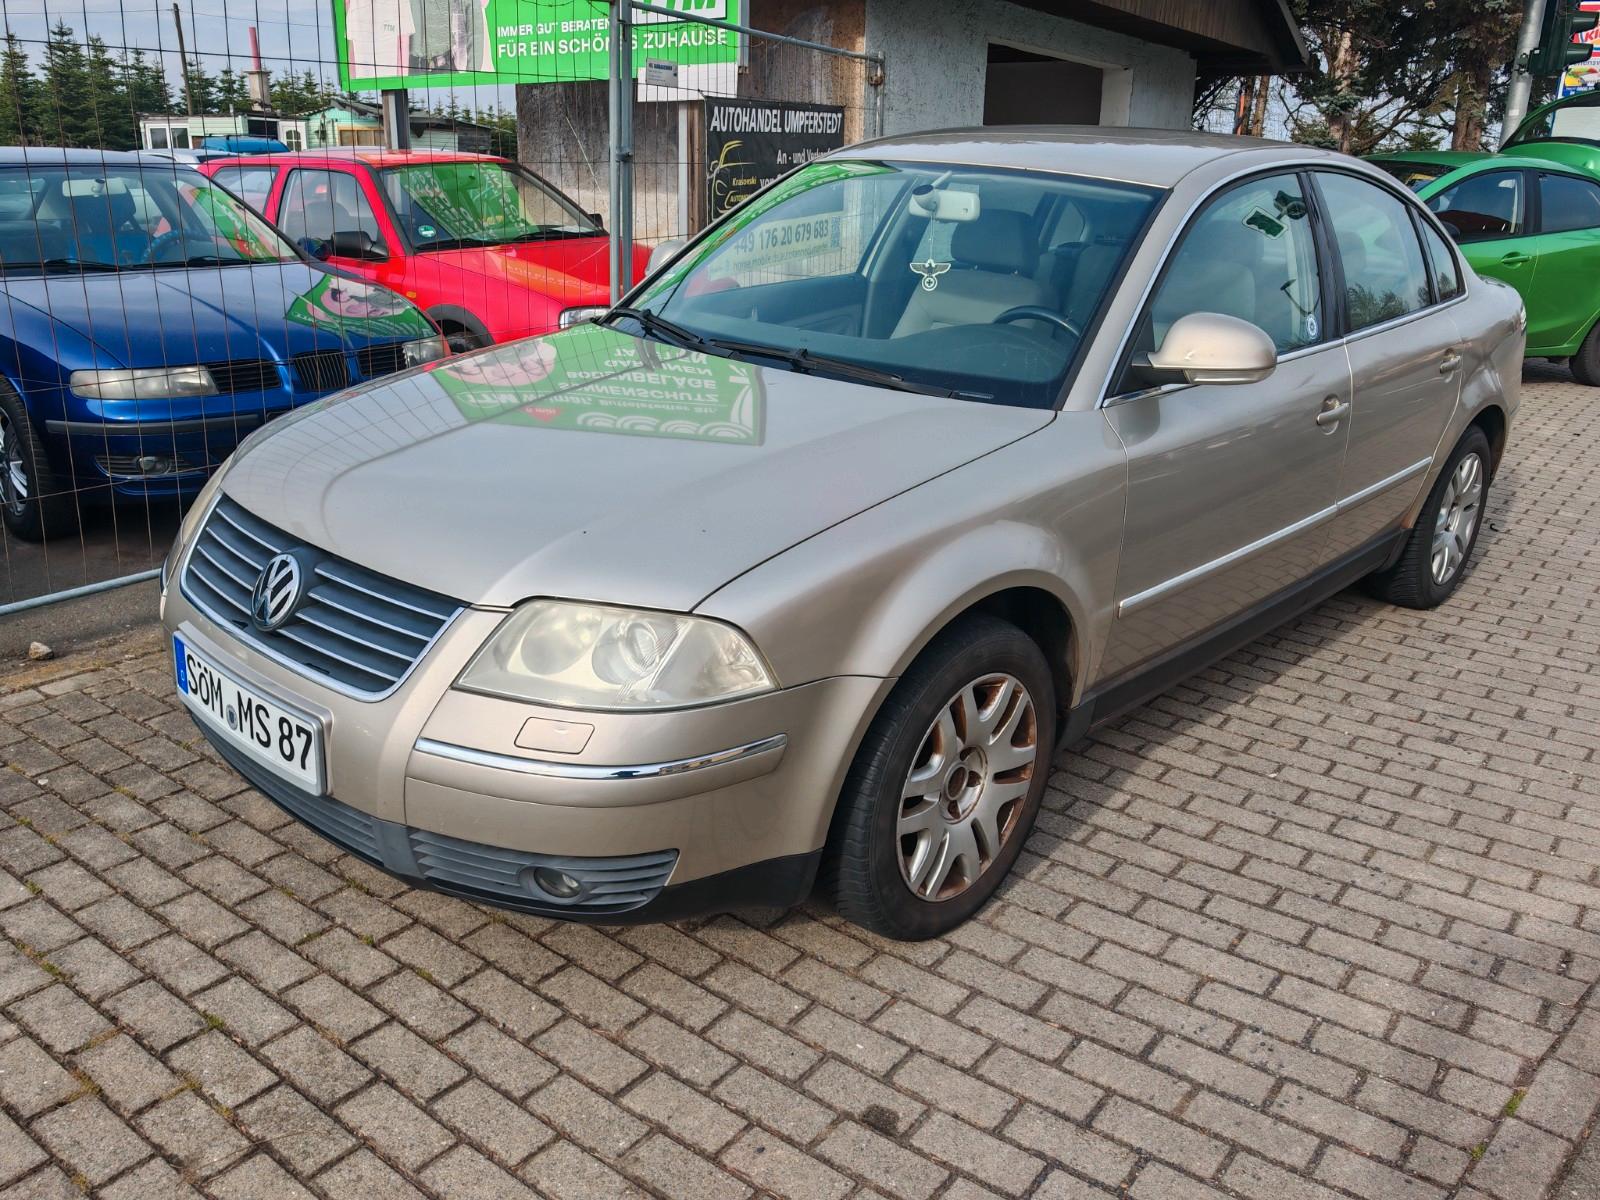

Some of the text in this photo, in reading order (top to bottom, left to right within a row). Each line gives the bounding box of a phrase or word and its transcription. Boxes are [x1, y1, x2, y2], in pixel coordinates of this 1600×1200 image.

[497, 24, 533, 37] IMMER
[536, 21, 559, 35] GUT
[498, 28, 728, 58] FÜR EIN SCHÖS ZUHAUSE
[710, 106, 843, 134] AUTOHANDEL UMPFERSTEDT
[776, 149, 788, 165] An
[792, 147, 806, 164] und
[734, 219, 829, 255] +49 176 20 679 683
[187, 654, 313, 770] SÖM MS 87
